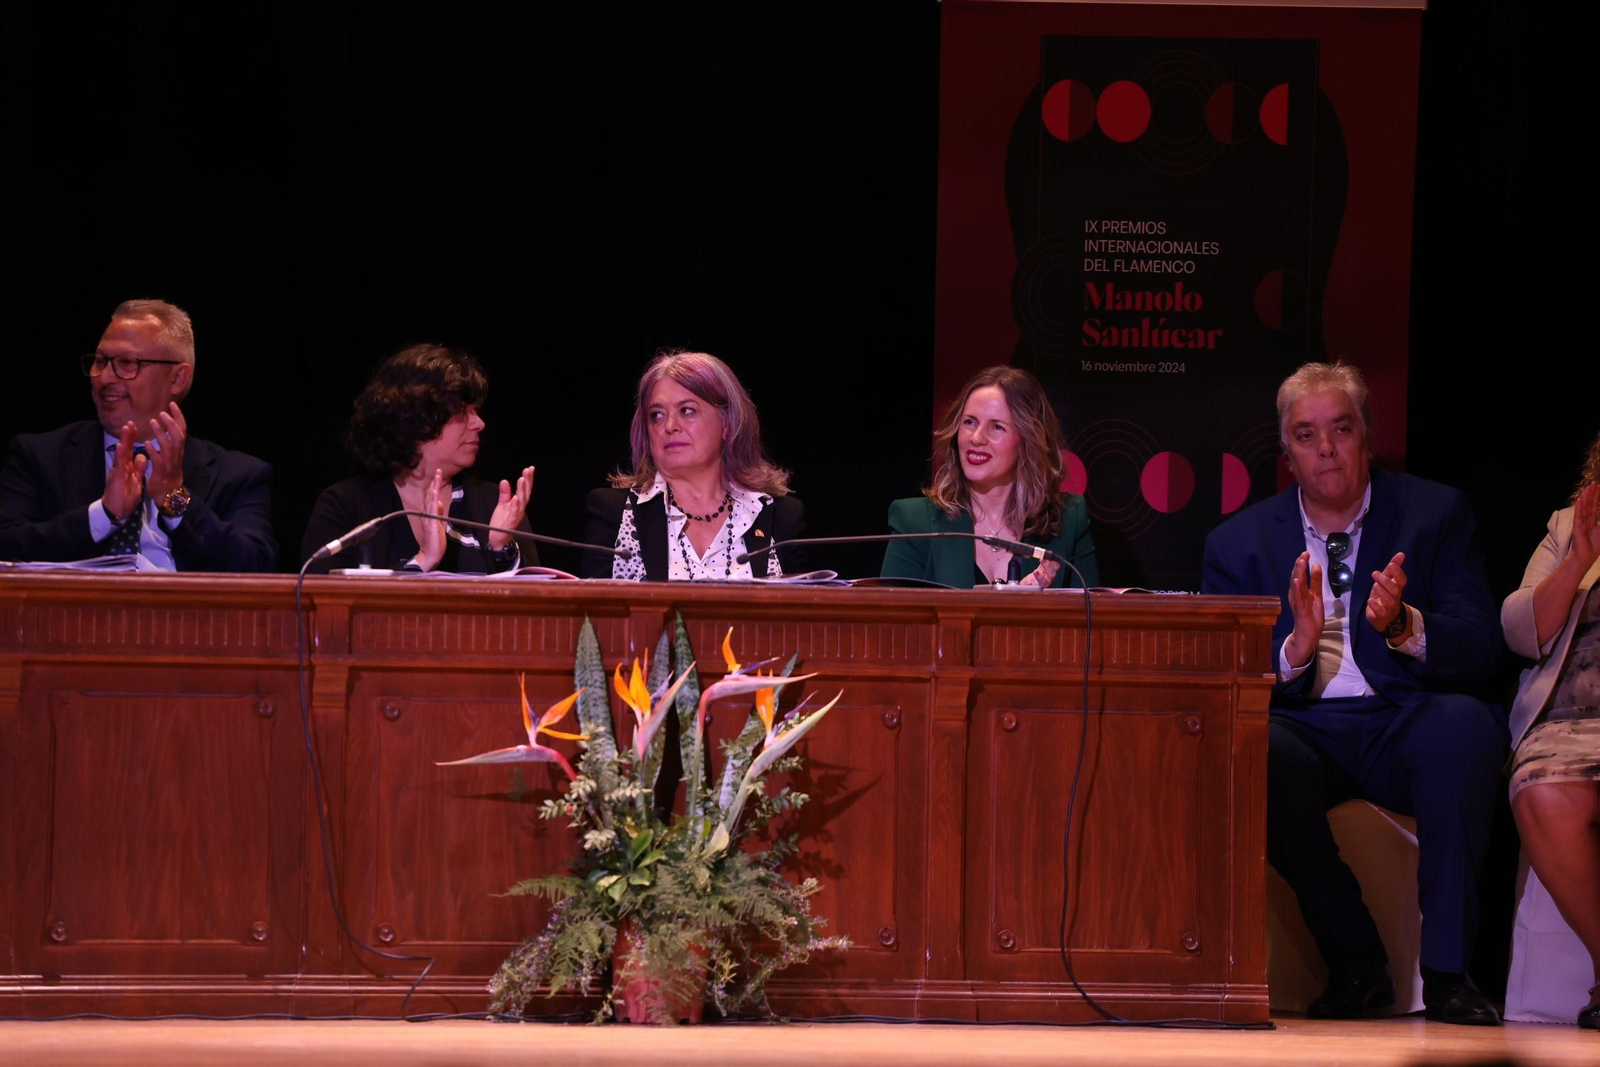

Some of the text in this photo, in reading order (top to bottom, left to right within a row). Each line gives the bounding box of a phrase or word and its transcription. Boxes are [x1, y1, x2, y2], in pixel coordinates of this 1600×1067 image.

[1084, 219, 1167, 235] IX PREMIOS
[1084, 239, 1220, 255] INTERNACIONALES
[1083, 258, 1196, 274] DEL FLAMENCO
[1083, 280, 1204, 313] Manolo
[1081, 316, 1225, 350] Sanlúcar
[1080, 359, 1187, 373] 16 noviembre 2024
